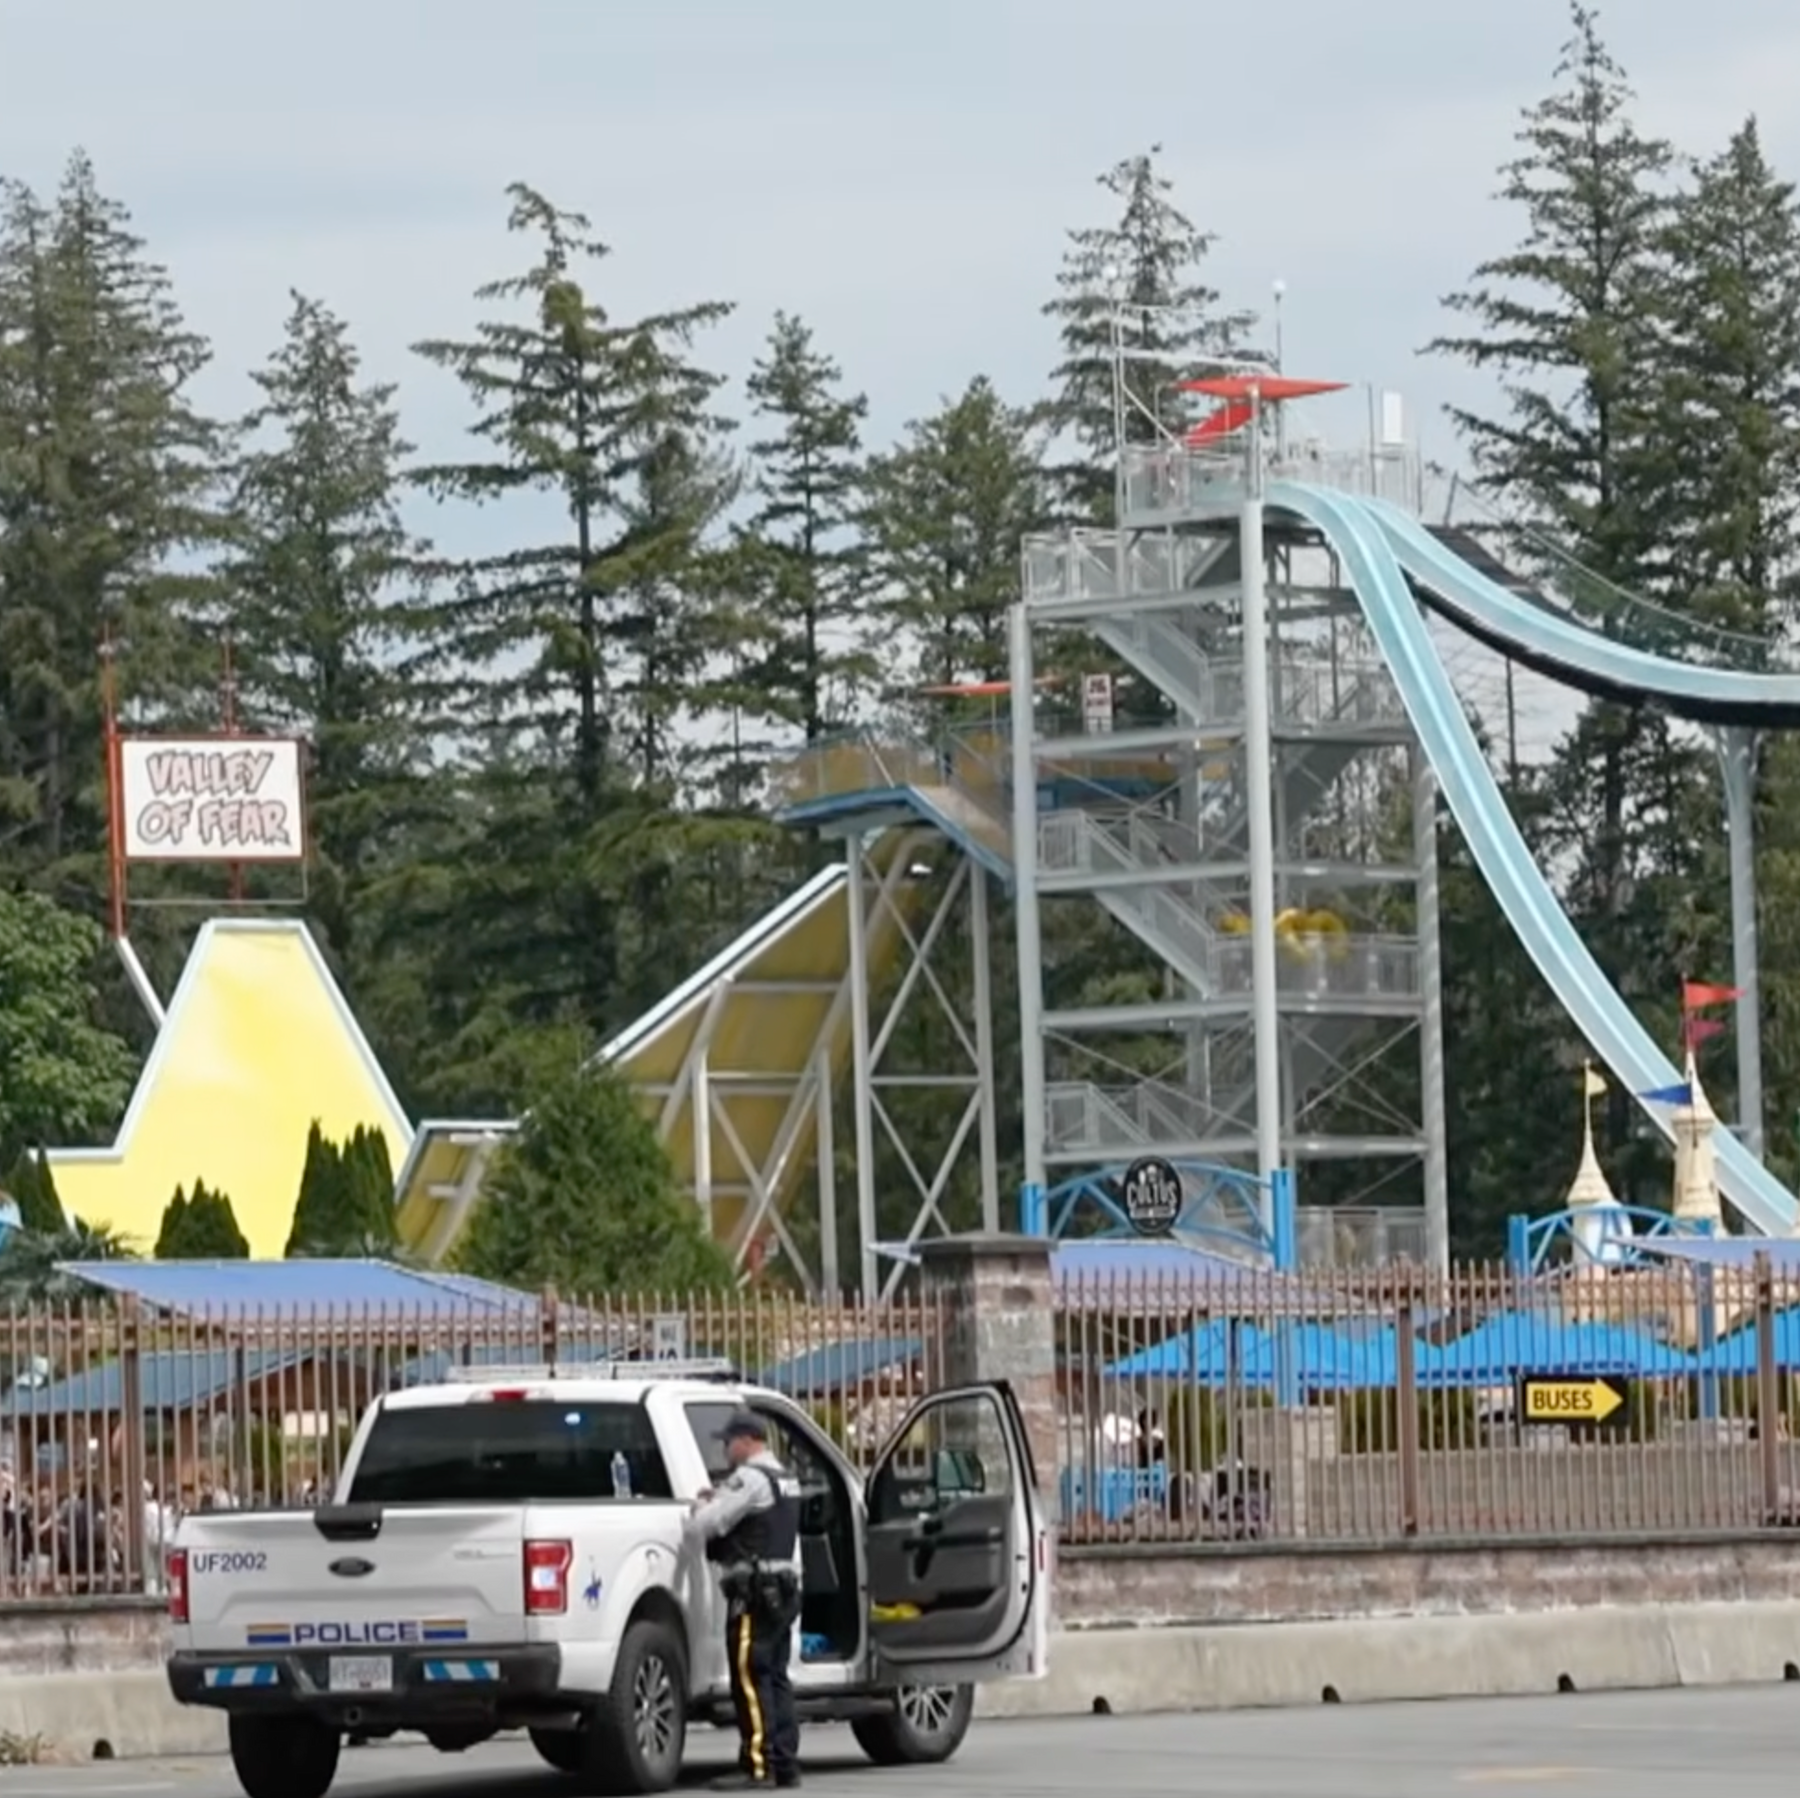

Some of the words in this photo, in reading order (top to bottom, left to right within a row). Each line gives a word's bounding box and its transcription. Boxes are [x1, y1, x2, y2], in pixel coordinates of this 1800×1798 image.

[146, 750, 274, 797] VALLEY
[137, 799, 193, 846] OF
[198, 798, 292, 847] FEAR
[1533, 1389, 1593, 1411] BUSES
[193, 1551, 267, 1574] UF2002
[294, 1621, 419, 1643] POLICE
